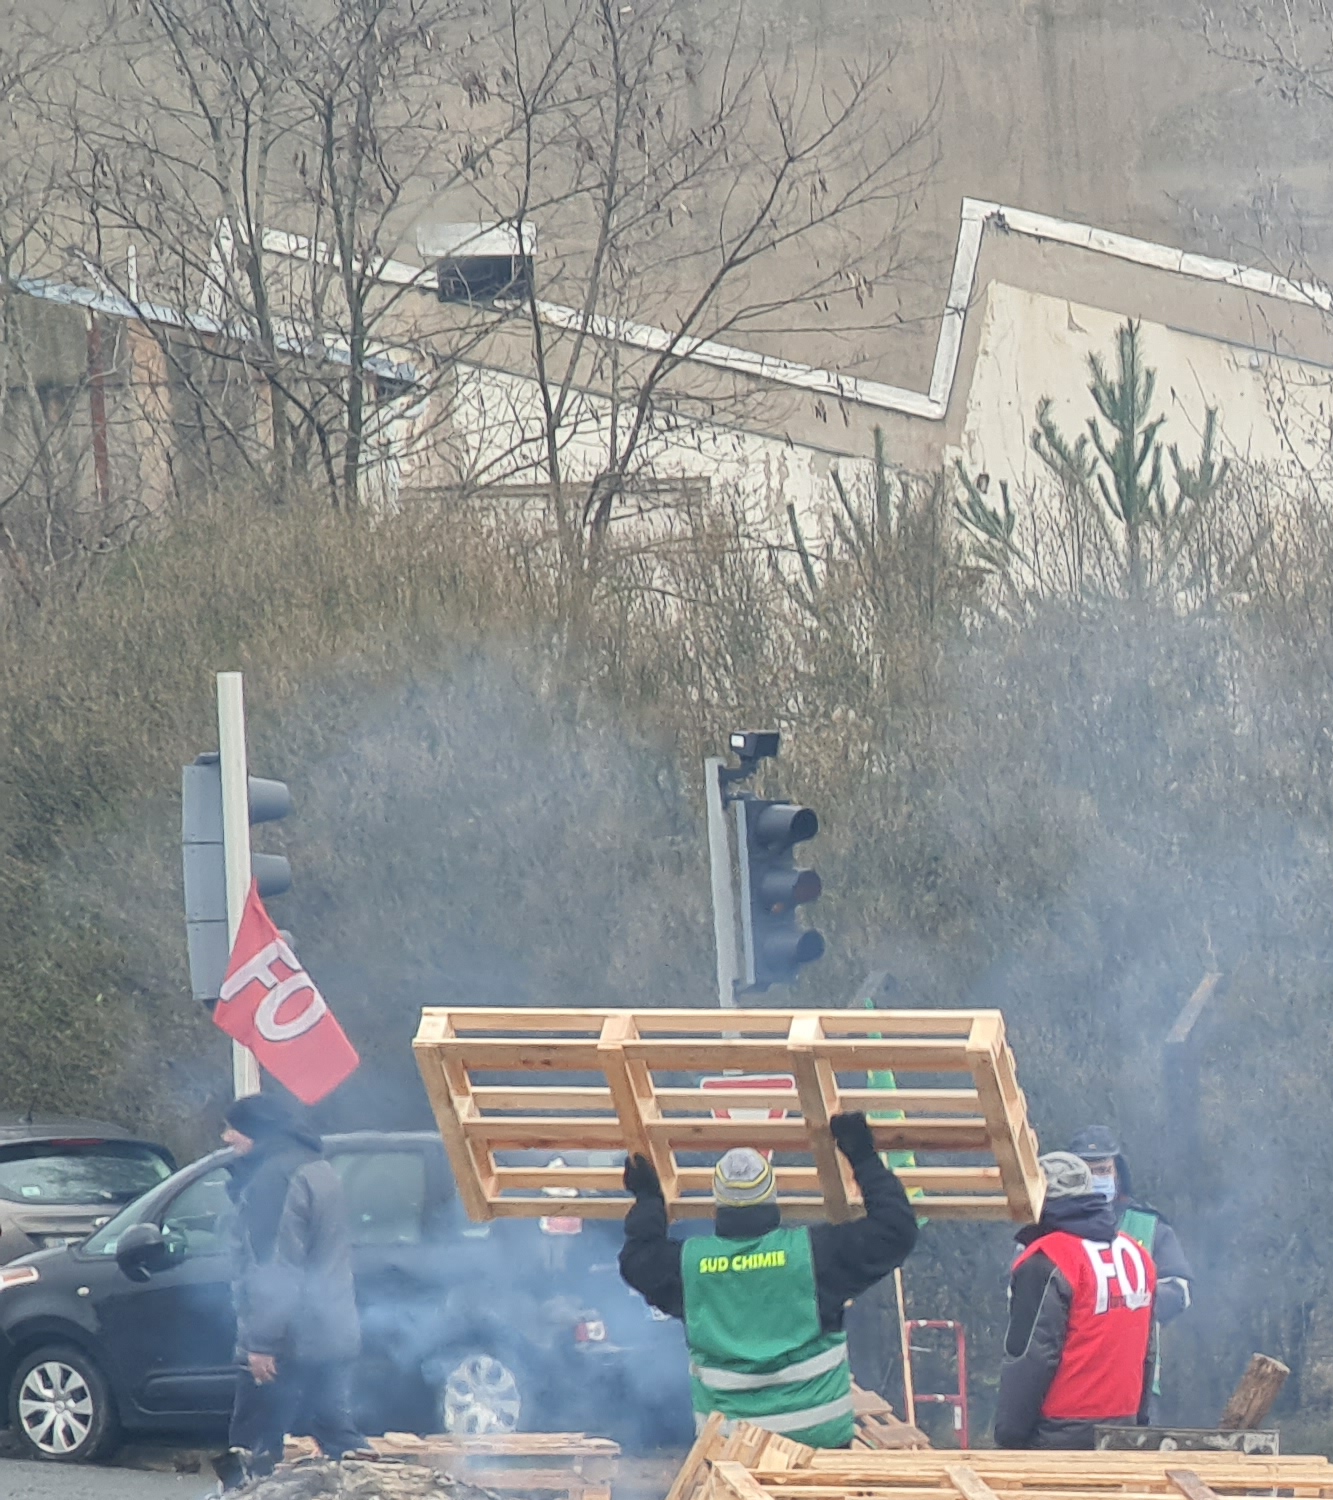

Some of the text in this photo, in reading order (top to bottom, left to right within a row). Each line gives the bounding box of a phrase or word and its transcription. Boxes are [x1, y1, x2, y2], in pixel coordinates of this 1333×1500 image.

[219, 937, 327, 1042] FO
[699, 1250, 786, 1274] SUD CHIMIE
[1081, 1235, 1152, 1315] FO
